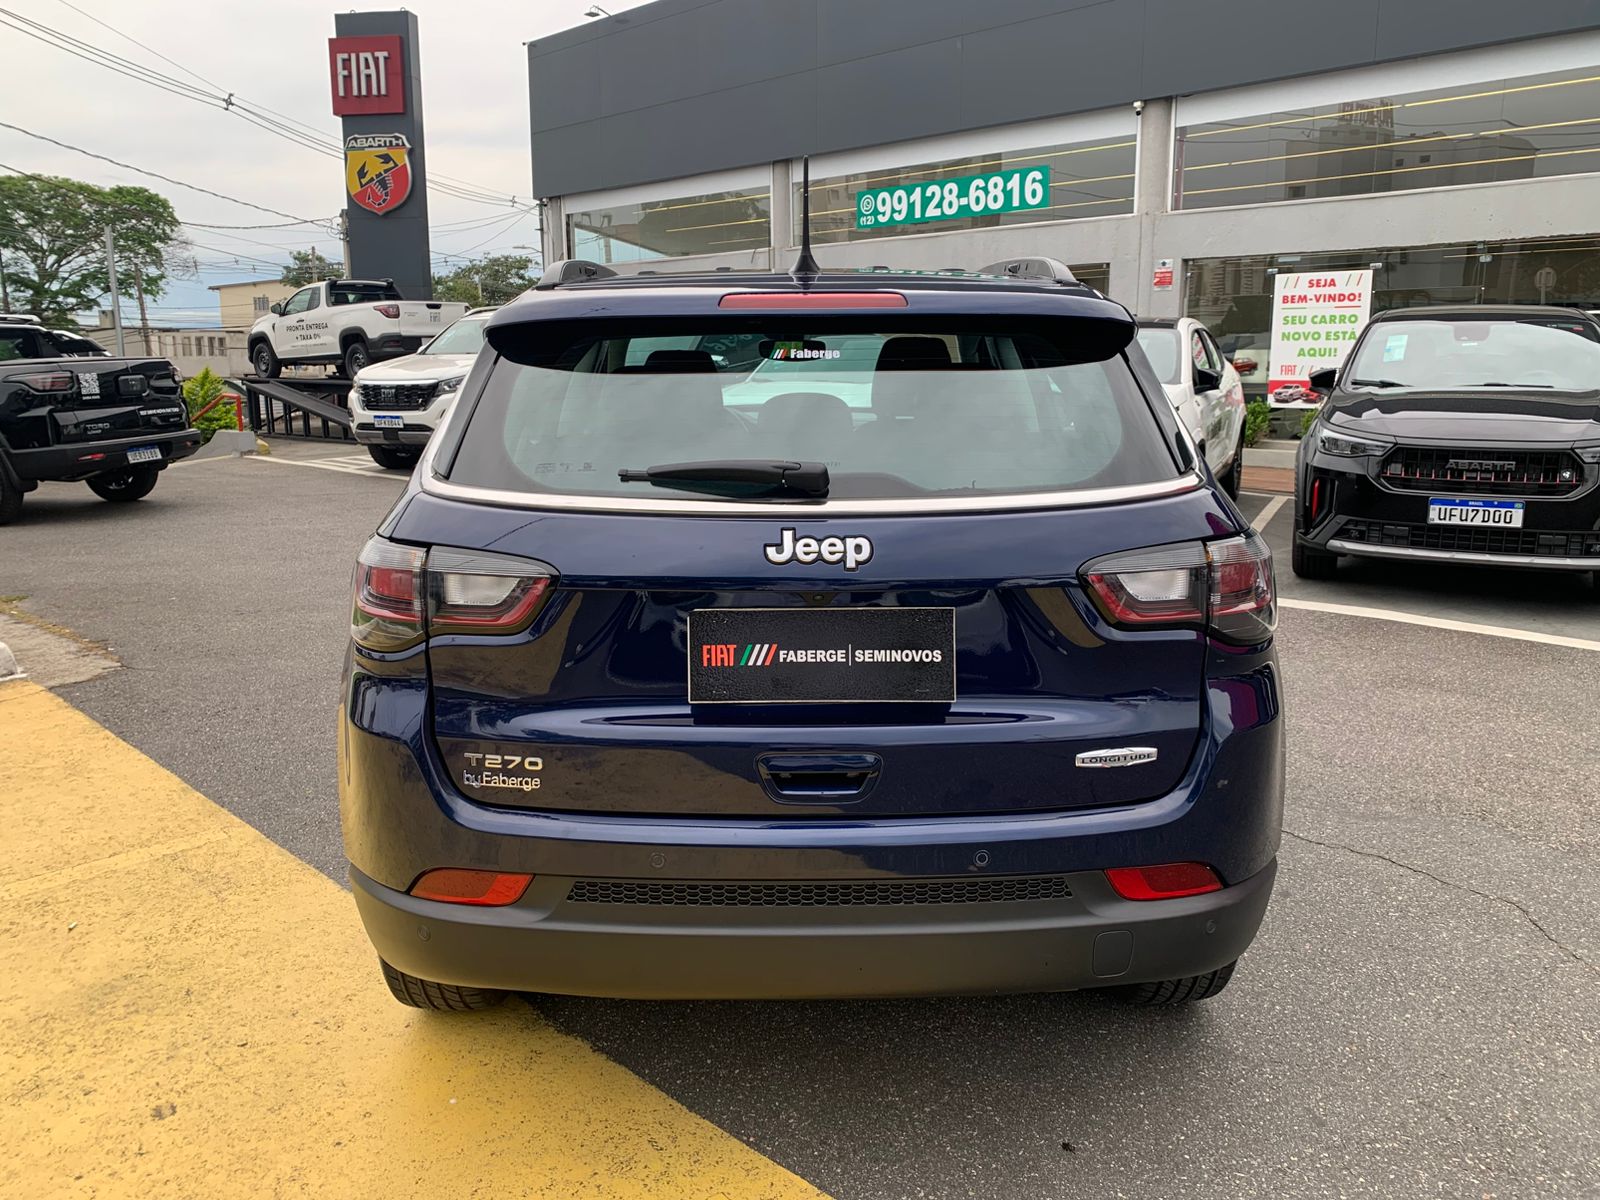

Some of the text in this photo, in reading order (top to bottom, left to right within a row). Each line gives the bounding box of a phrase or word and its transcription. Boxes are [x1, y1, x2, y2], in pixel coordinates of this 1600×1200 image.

[336, 51, 389, 97] FIAT
[349, 137, 403, 147] ABARTH
[860, 170, 1043, 225] (12) 99128-6816
[1308, 278, 1337, 288] SEJA
[1282, 292, 1362, 304] BEM-VINDO!
[1282, 314, 1359, 325] SEU CARRO
[286, 322, 328, 332] PRONTA ENTREGA
[1281, 327, 1358, 341] NOVO ESTÁ
[790, 348, 841, 360] Faberge
[1297, 347, 1338, 358] AQUI!
[1280, 364, 1297, 376] FIAT
[86, 422, 110, 430] TORO
[1445, 459, 1516, 471] ABARTH
[1437, 507, 1513, 524] UFU7D00
[764, 528, 873, 570] Jeep
[702, 644, 942, 667] FIAT FABERGE SEMINOVOS
[463, 752, 544, 770] T270
[1081, 753, 1154, 764] LONGITUDE
[463, 769, 541, 791] by Faberge
